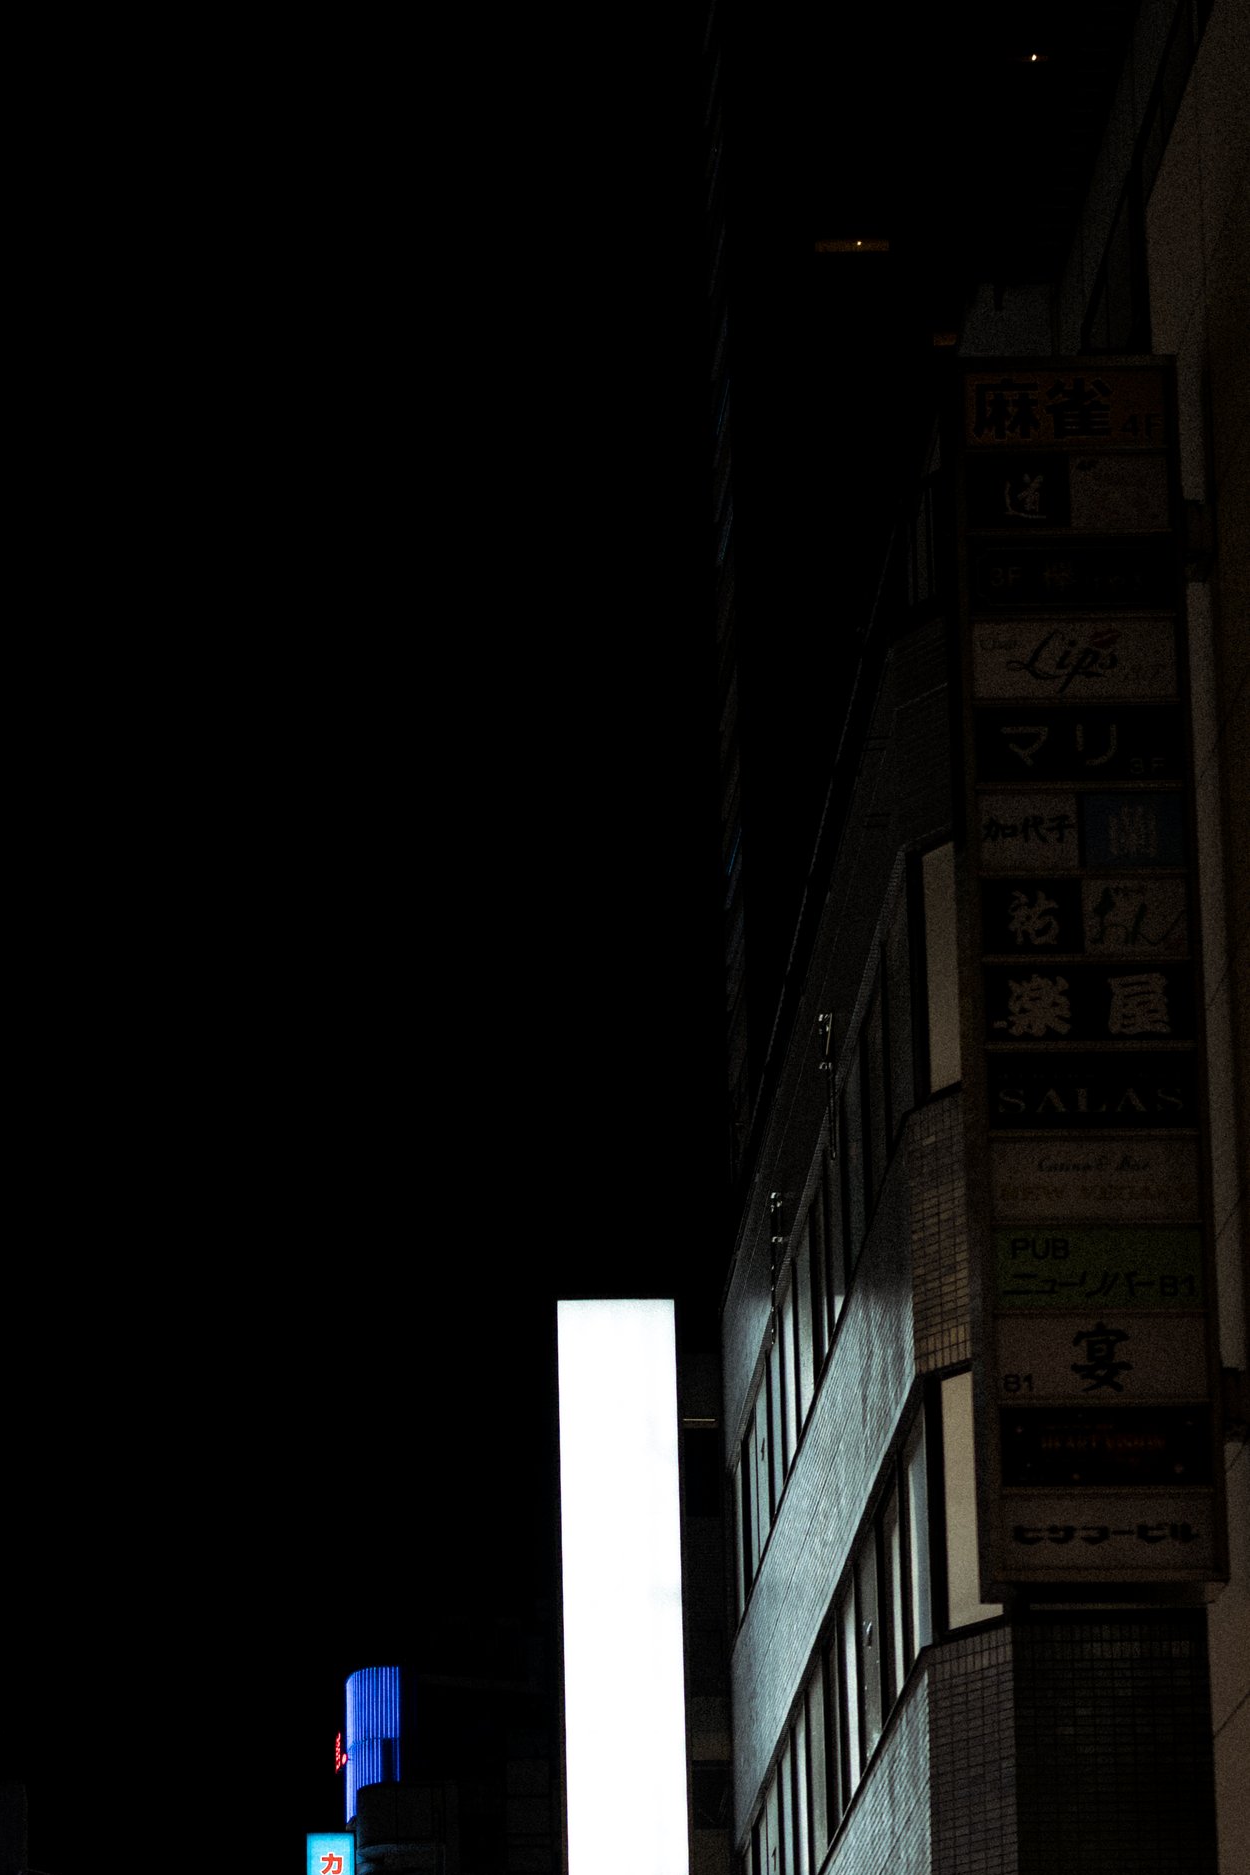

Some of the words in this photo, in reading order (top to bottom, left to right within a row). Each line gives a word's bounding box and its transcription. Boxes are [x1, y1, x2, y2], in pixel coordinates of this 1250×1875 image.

[974, 379, 1112, 439] 麻雀
[1121, 414, 1162, 438] 4F
[1006, 631, 1119, 694] Lips
[999, 722, 1119, 767] マリ
[983, 814, 1074, 842] 加代子
[997, 1086, 1185, 1114] SALAS
[1011, 1238, 1070, 1260] PUB
[1003, 1272, 1155, 1298] ニューリバー
[1071, 1323, 1132, 1392] 宴
